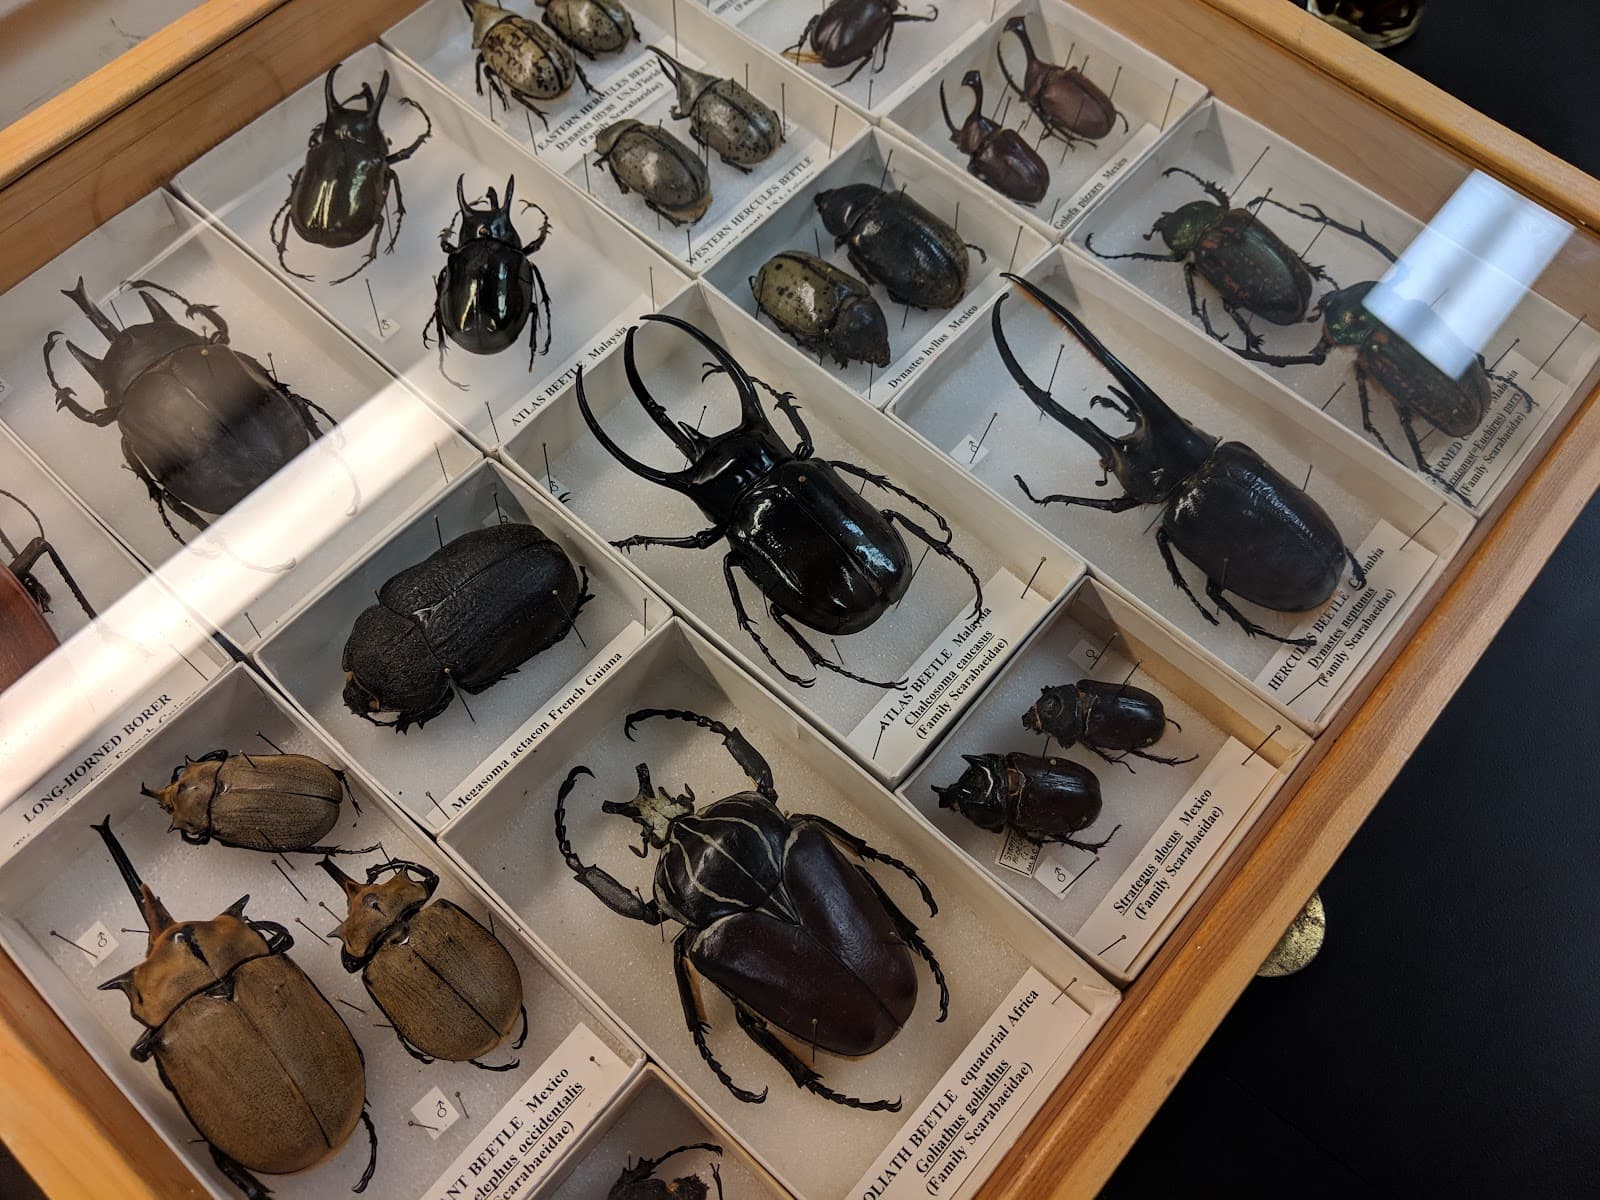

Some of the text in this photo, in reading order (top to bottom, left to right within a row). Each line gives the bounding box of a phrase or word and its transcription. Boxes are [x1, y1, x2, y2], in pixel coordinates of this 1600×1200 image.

[537, 114, 581, 151] EASTERN
[628, 58, 659, 79] BEETL
[686, 224, 732, 266] WESTERN
[731, 184, 779, 227] HERCULES
[778, 156, 813, 186] BEETLE
[948, 305, 978, 331] Mexico
[511, 394, 546, 427] ATLAS
[588, 325, 628, 360] Malaysia
[1459, 464, 1490, 498] (Family
[1483, 411, 1527, 465] Scarabaeidae)
[904, 629, 995, 729] Chalcosoma caucasus
[1267, 632, 1317, 692] HERCULS
[1312, 590, 1350, 634] BEETLE
[1306, 587, 1378, 671] Dynastes neptunus
[1317, 588, 1397, 688] (Family Scarabaeidae)
[451, 652, 623, 812] Megasoma actaeon French Guiana
[878, 690, 915, 729] ATLAS
[910, 648, 953, 694] BEETLE
[915, 638, 1009, 740] (Family Scarabaeidae)
[23, 734, 122, 824] LONG-HORNED
[122, 693, 172, 737] BORER
[1113, 789, 1213, 916] Strategus aloeus Mexico
[1134, 806, 1225, 921] (Family Scarabaeidae)
[467, 1115, 524, 1177] BEETLE
[525, 1068, 569, 1113] Mexico
[518, 1081, 586, 1157] occidentalis
[863, 988, 1040, 1200] OLIATH BEETLE equatorial Africa
[915, 1057, 1012, 1178] Goliathus goliathus
[925, 1061, 1035, 1197] (Family Scarabaeidae)
[496, 1120, 576, 1200] carabaeidae)
